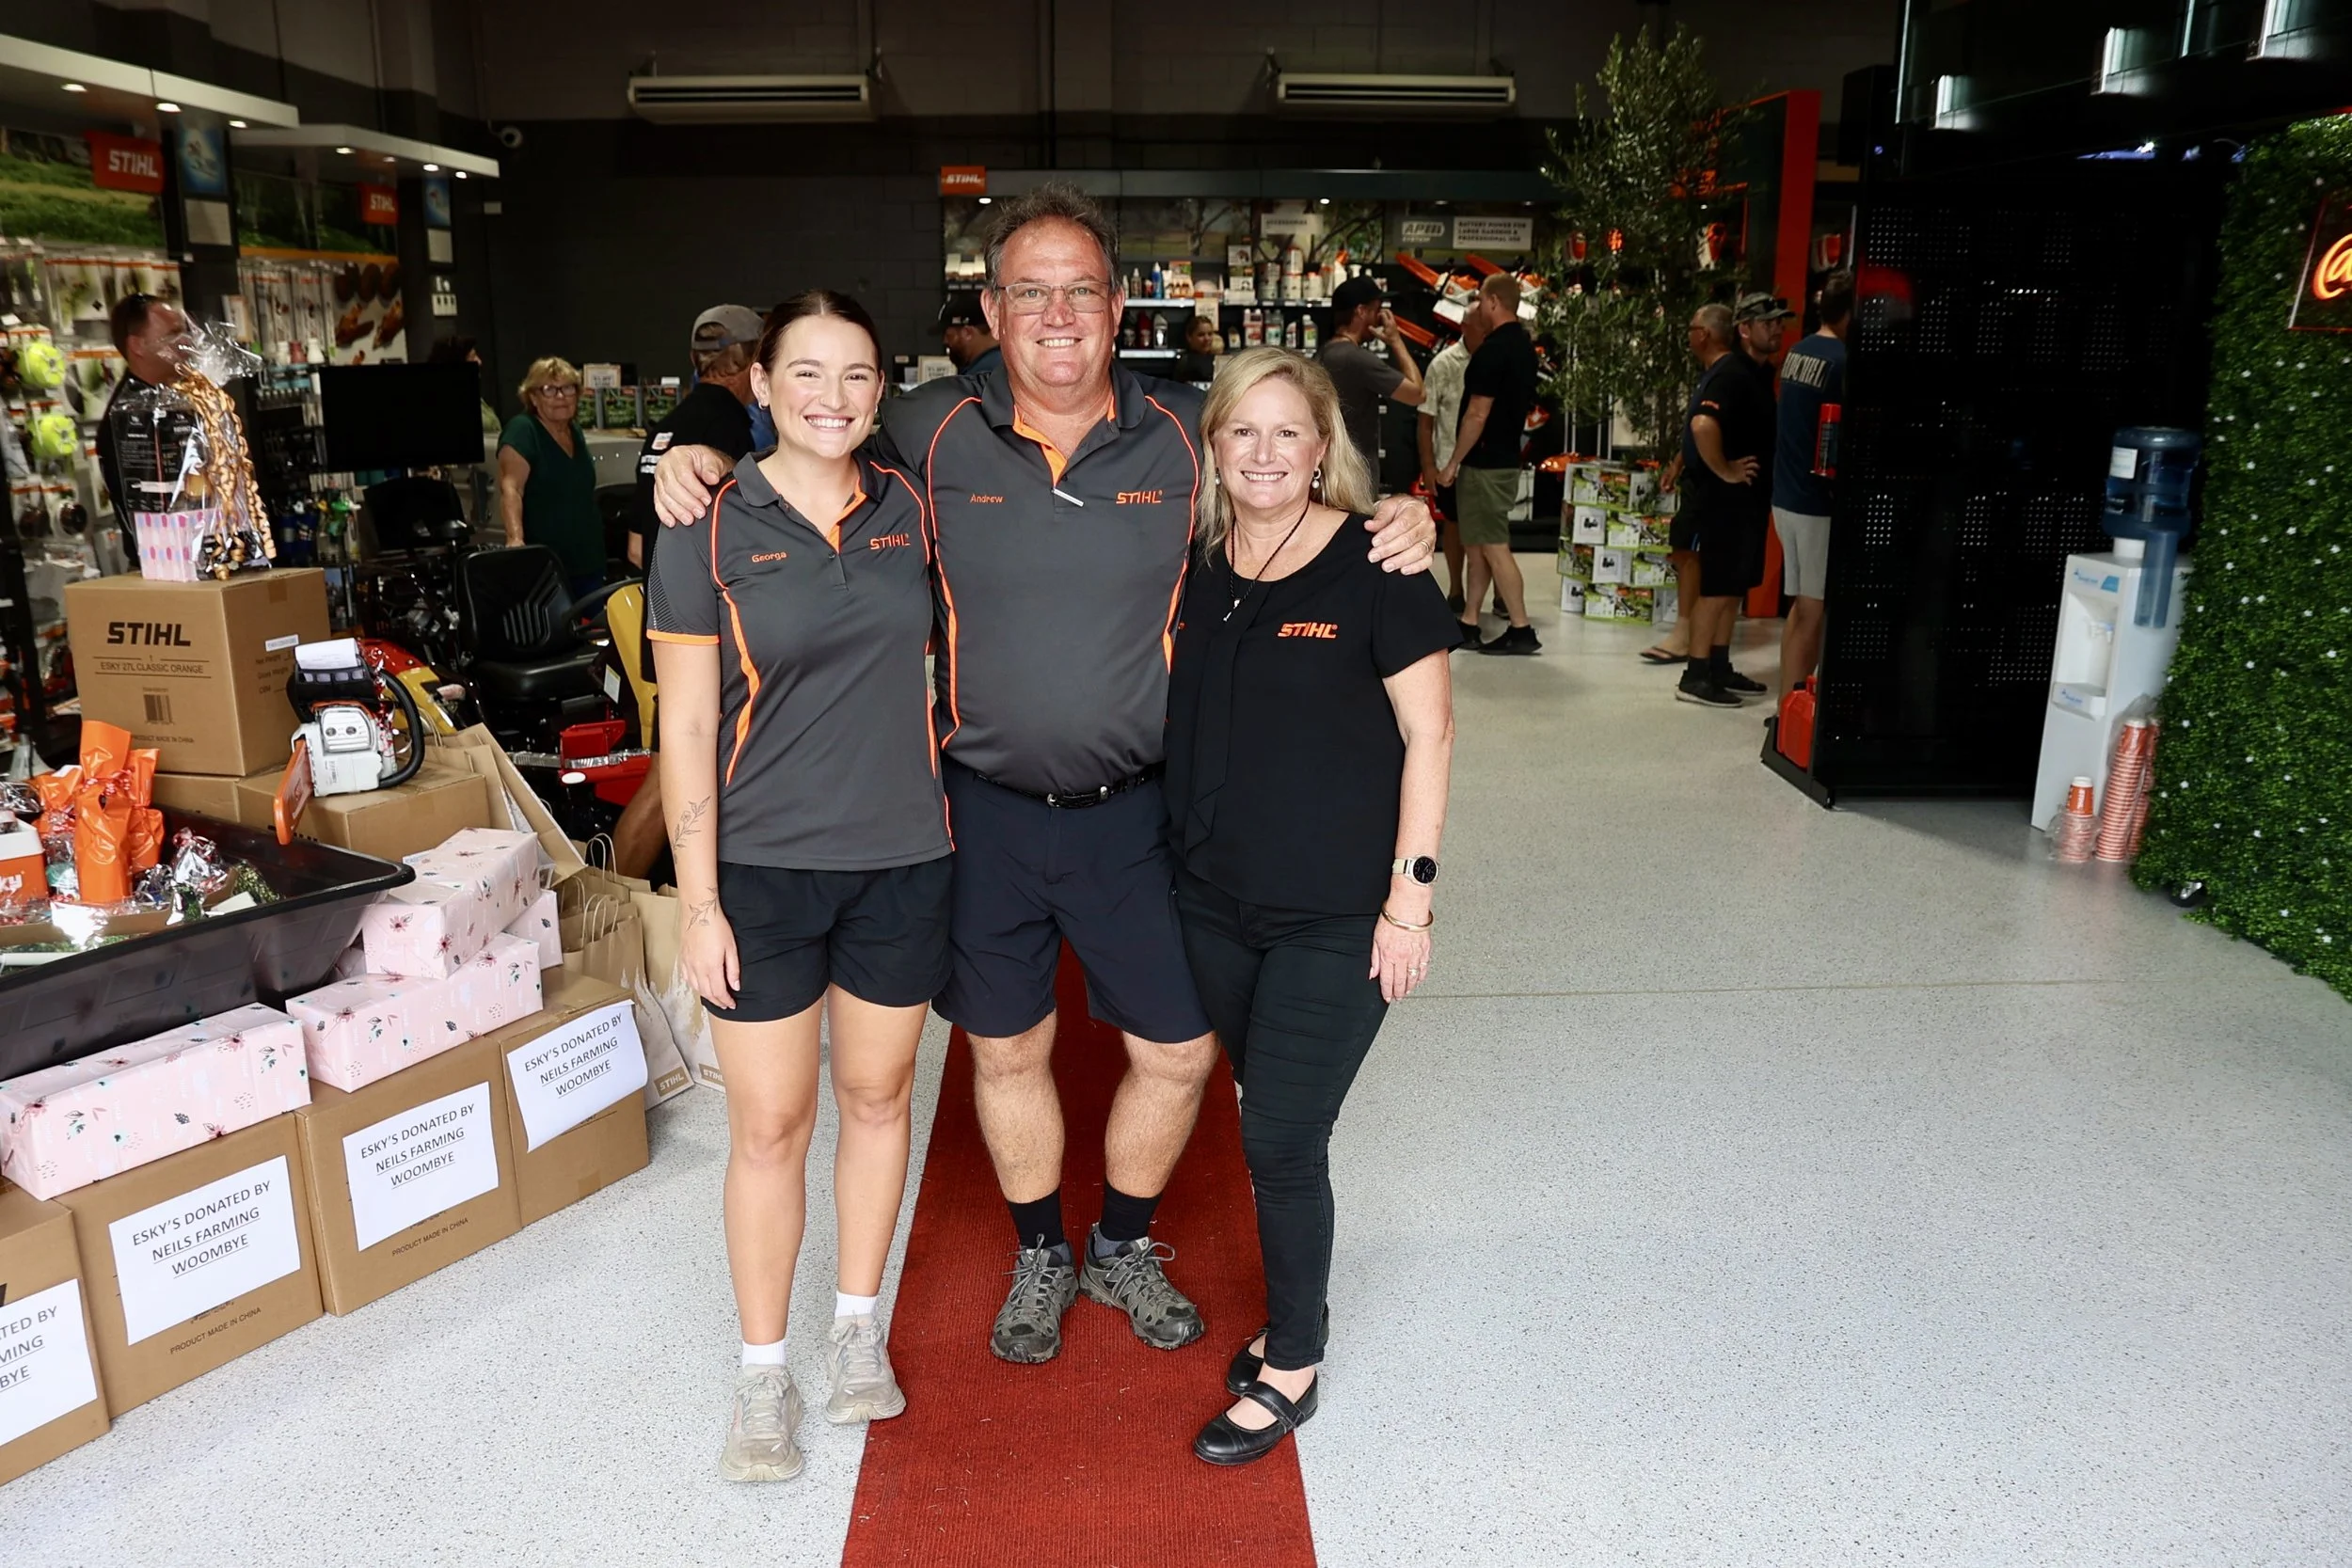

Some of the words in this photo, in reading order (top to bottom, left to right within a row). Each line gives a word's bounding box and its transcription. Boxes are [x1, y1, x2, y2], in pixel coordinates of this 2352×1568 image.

[108, 150, 159, 178] STIHL
[946, 174, 980, 184] STIHL
[970, 494, 1004, 503] Andrew
[107, 622, 191, 646] STIHL
[101, 661, 120, 671] ESKY
[136, 663, 169, 673] CLASSIC
[170, 664, 204, 674] ORANGE
[525, 1047, 560, 1072] ESKY'S
[561, 1023, 610, 1053] DONATED
[611, 1013, 623, 1027] BY
[540, 1062, 569, 1085] NEILS
[571, 1037, 618, 1069] FARMING
[555, 1059, 612, 1096] WOOMBYE
[660, 1073, 685, 1090] STIHL
[703, 1069, 724, 1082] STIHL
[361, 1133, 399, 1159] ESKY'S
[402, 1110, 457, 1141] DONATED
[461, 1103, 475, 1117] BY
[376, 1150, 407, 1173] NEILS
[410, 1127, 465, 1158] FARMING
[390, 1151, 454, 1186] WOOMBYE
[133, 1217, 181, 1246] ESKY'S
[184, 1189, 250, 1226] DONATED
[254, 1180, 271, 1196] BY
[152, 1235, 192, 1261] NEILS
[196, 1207, 260, 1243] FARMING
[392, 1239, 422, 1257] PRODUCT
[423, 1230, 440, 1243] MADE
[450, 1217, 469, 1230] CHINA
[171, 1233, 248, 1275] WOOMBYE
[0, 1317, 32, 1340] TED
[38, 1306, 57, 1323] BY
[170, 1333, 206, 1354] PRODUCT
[208, 1323, 229, 1338] MADE
[230, 1318, 237, 1326] IN
[239, 1307, 262, 1323] CHINA
